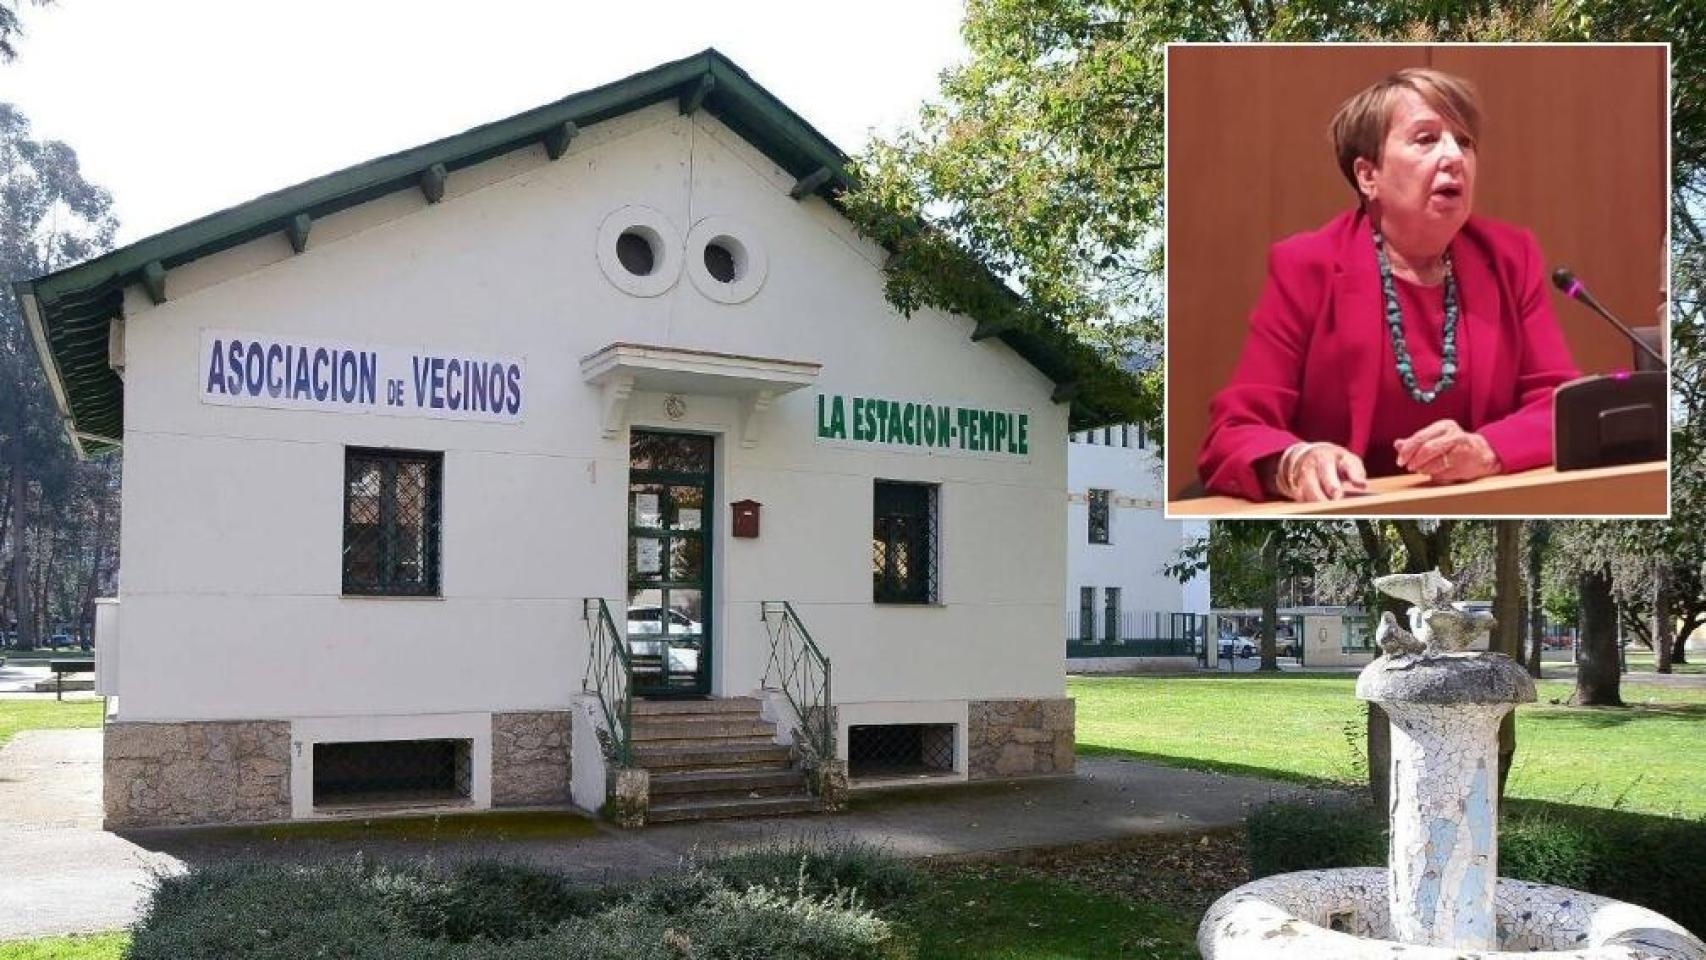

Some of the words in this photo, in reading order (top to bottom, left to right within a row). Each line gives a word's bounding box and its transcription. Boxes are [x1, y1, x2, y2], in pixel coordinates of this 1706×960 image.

[207, 340, 377, 406] ASOCIACION
[387, 379, 404, 406] DE
[413, 355, 521, 415] VECINOS
[818, 394, 846, 439] LA
[852, 398, 1028, 454] ESTACION-TEMPLE
